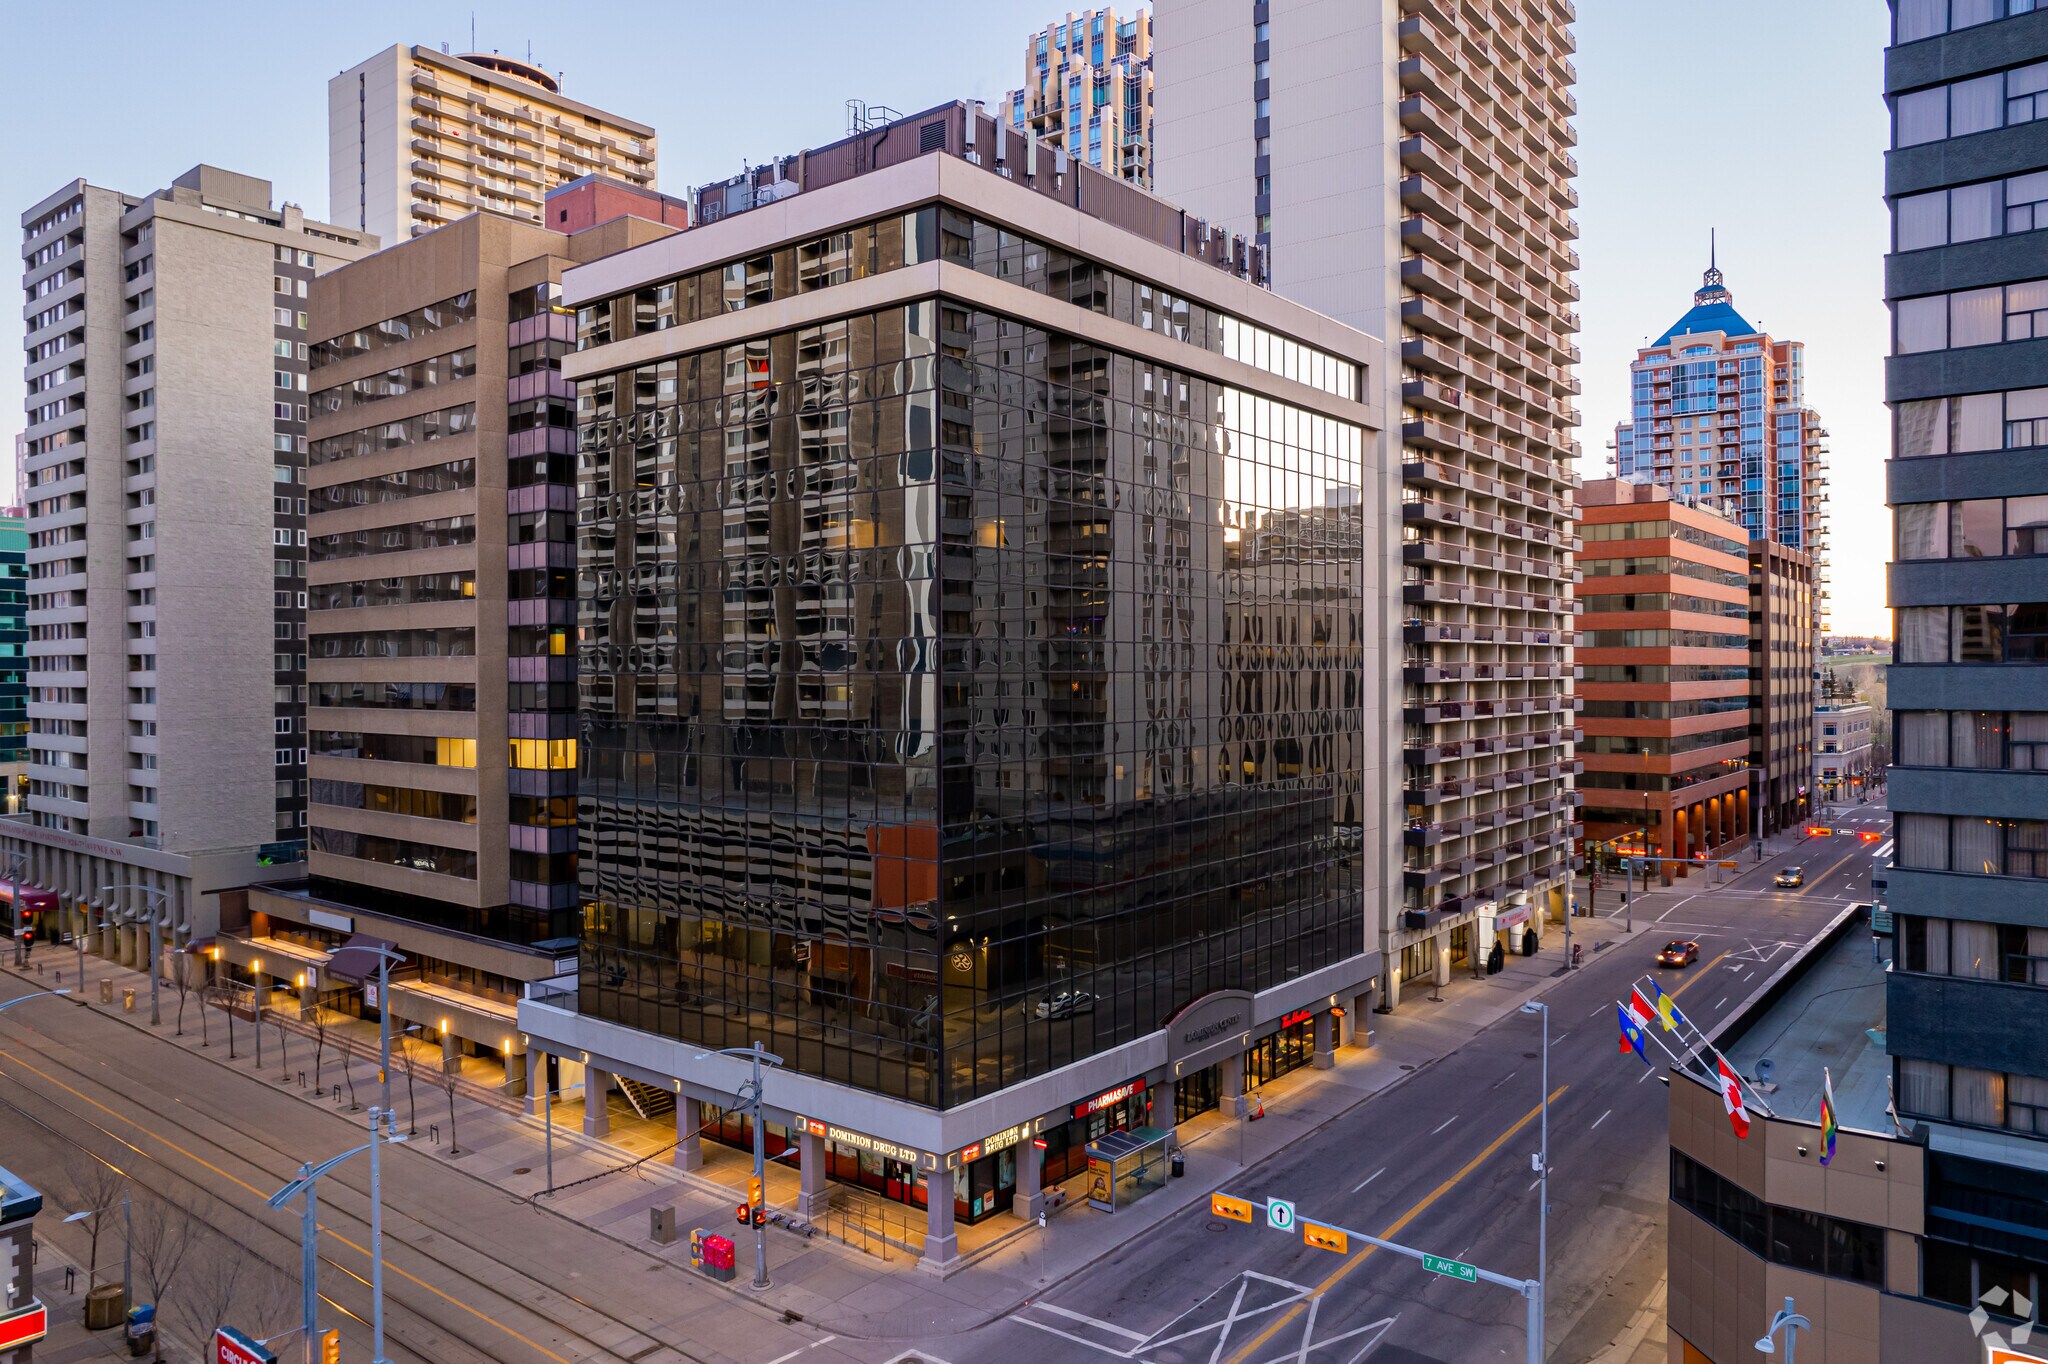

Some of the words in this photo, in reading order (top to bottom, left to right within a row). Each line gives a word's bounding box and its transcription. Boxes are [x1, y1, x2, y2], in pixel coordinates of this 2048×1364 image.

[1088, 1083, 1135, 1113] PHARMASAVE
[829, 1127, 871, 1149] DOMINION
[873, 1140, 897, 1156] DRUG
[899, 1148, 917, 1162] LTD
[985, 1126, 1019, 1147] DOMINION
[985, 1140, 1005, 1155] DRUG
[1005, 1134, 1019, 1146] LTD
[1426, 1257, 1432, 1267] 7
[1437, 1260, 1454, 1273] AVE
[1460, 1266, 1473, 1278] SW
